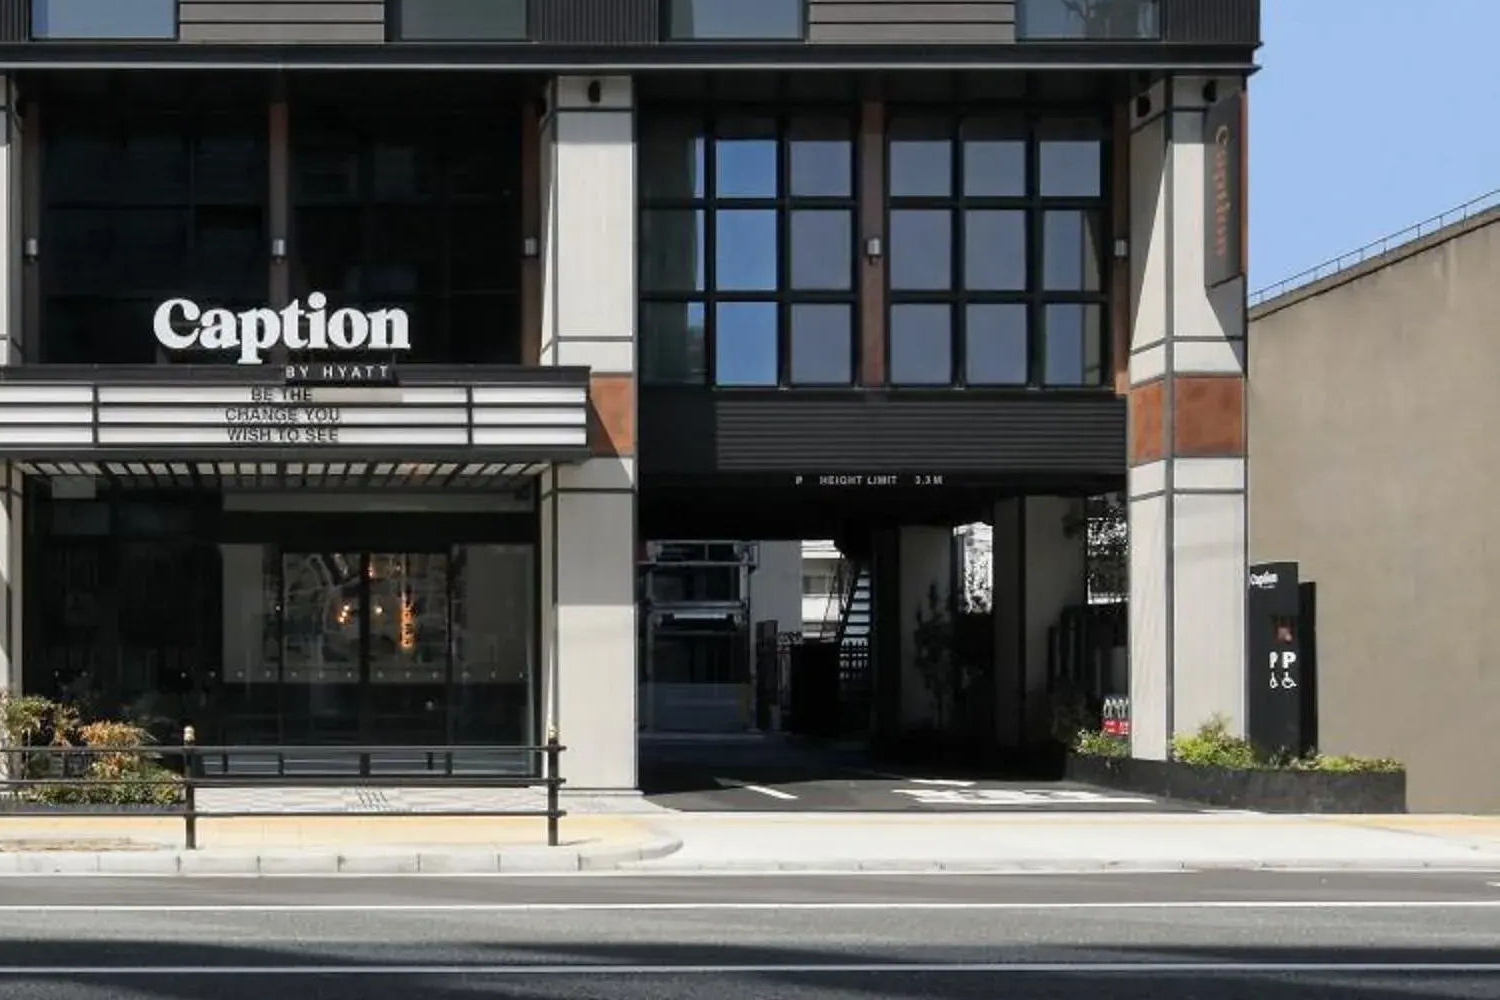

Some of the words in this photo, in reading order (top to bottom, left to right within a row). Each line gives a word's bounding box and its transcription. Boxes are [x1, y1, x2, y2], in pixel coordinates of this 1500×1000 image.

[153, 291, 411, 364] Caption
[285, 366, 308, 378] BY
[323, 366, 388, 378] HYATT
[251, 387, 276, 401] BE
[282, 387, 312, 401] THE
[225, 408, 297, 421] CHANGE
[304, 408, 340, 421] YOU
[227, 428, 271, 441] WISH
[277, 428, 299, 441] TO
[306, 428, 339, 441] SEE
[819, 475, 862, 485] HEIGHT
[867, 475, 898, 485] LIMIT
[1282, 651, 1297, 669] P
